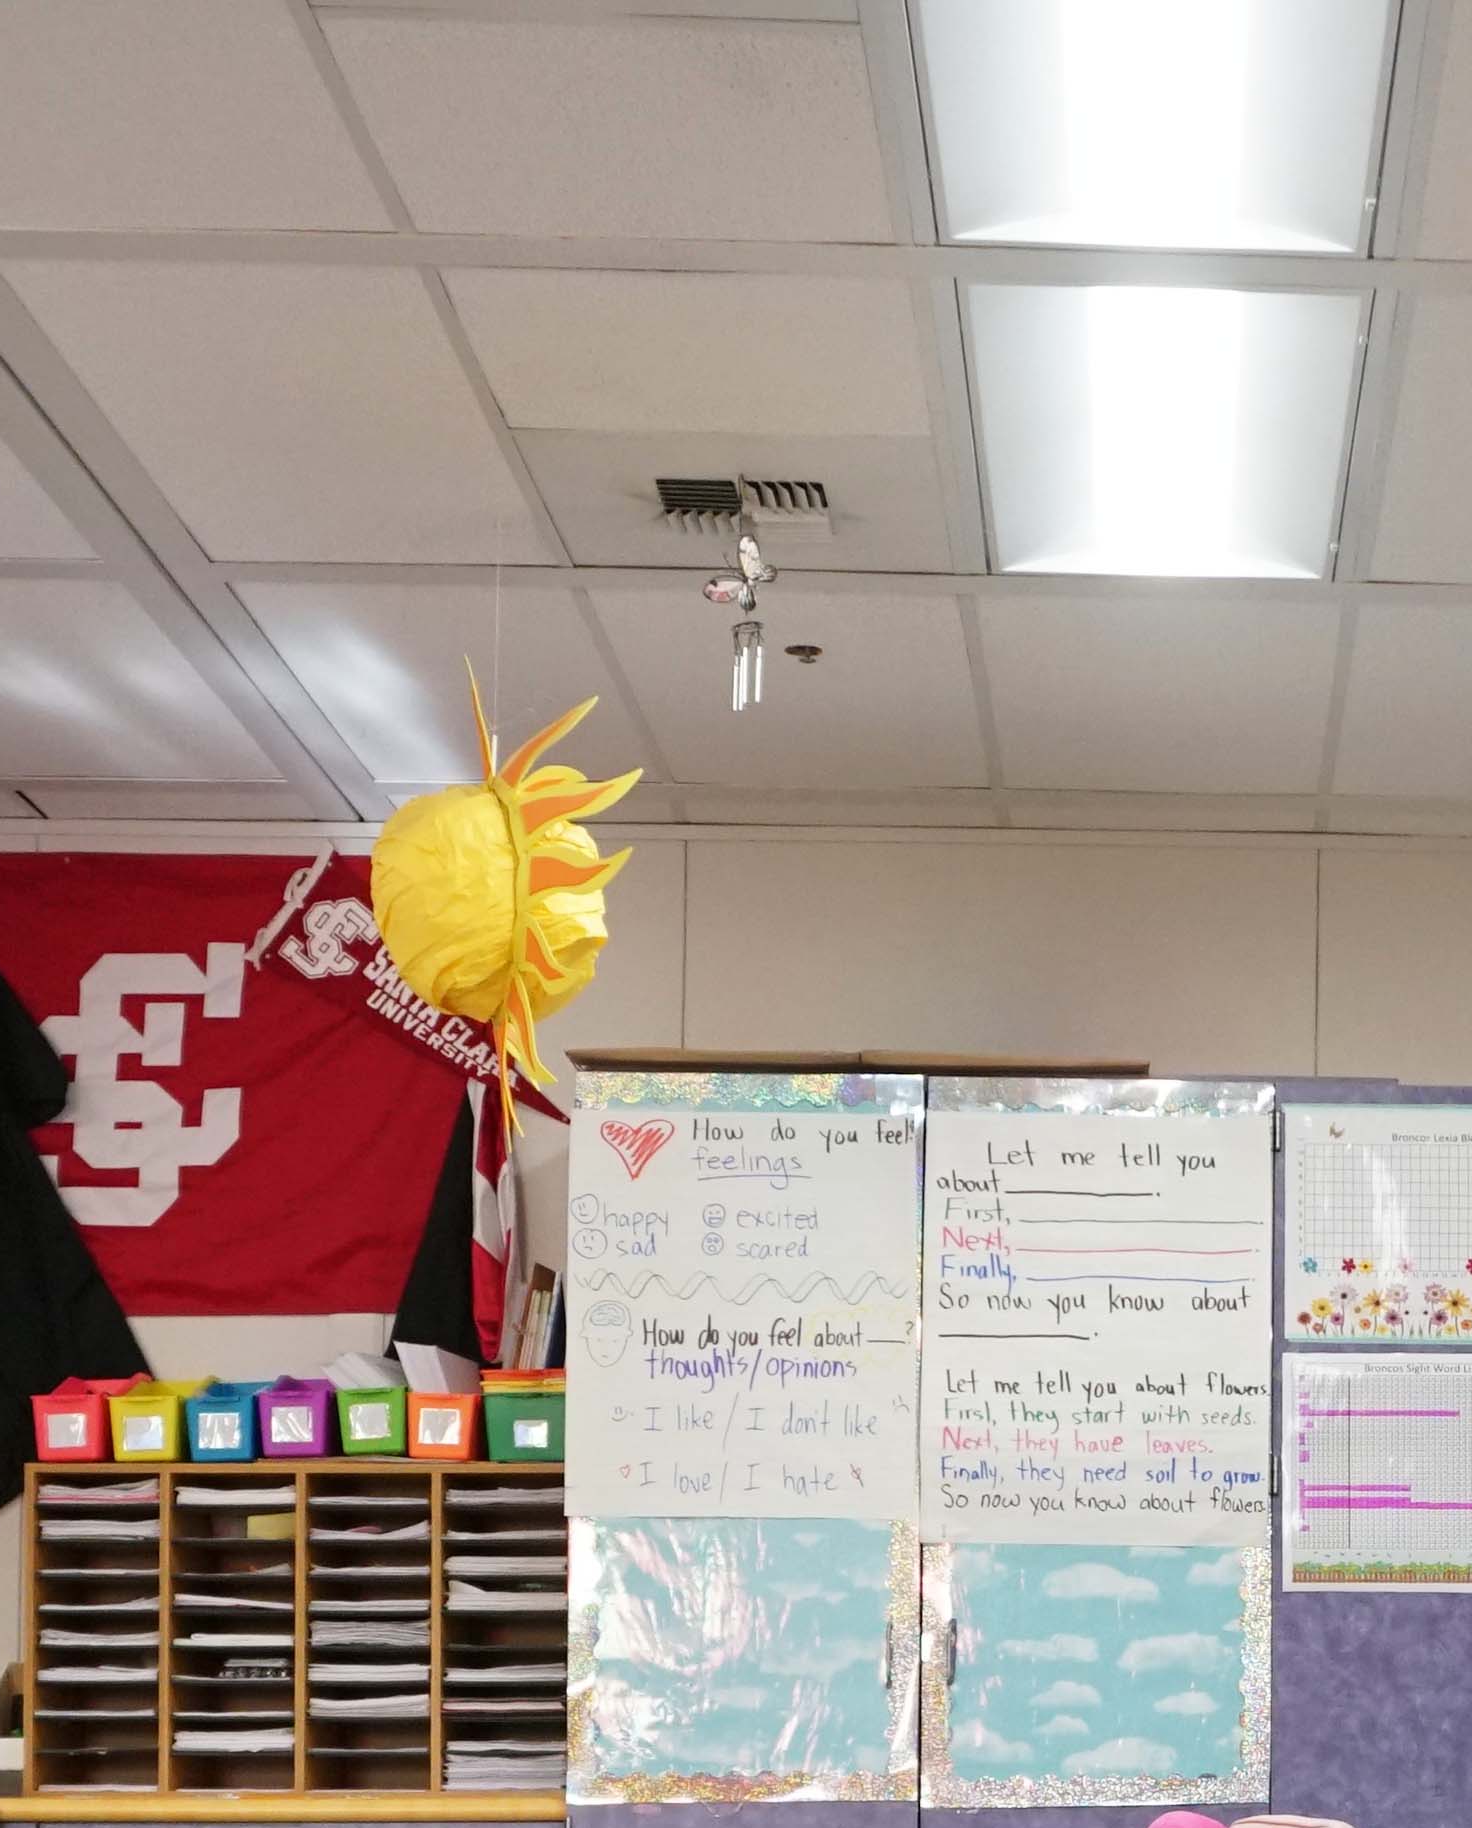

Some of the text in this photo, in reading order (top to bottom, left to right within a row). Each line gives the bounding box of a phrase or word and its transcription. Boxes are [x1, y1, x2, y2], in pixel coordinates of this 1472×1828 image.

[365, 988, 487, 1078] UNIVERSITY
[693, 1117, 743, 1141] How
[771, 1118, 796, 1141] do
[819, 1129, 858, 1154] you
[1434, 1133, 1458, 1143] Lexia
[691, 1148, 802, 1190] feelings
[988, 1139, 1215, 1177] Let me tell you
[936, 1168, 1000, 1193] about
[603, 1202, 819, 1236] happy excited
[944, 1197, 1011, 1225] First,
[616, 1235, 809, 1257] sad scared
[941, 1223, 1011, 1259] Next,
[940, 1252, 1017, 1293] Finally,
[939, 1282, 1251, 1325] So now you know about
[642, 1315, 863, 1358] How do you feel about
[946, 1369, 978, 1394] Let
[994, 1380, 1021, 1395] me
[1035, 1369, 1071, 1395] tell
[1081, 1381, 1117, 1405] you
[1136, 1372, 1188, 1396] about
[1364, 1364, 1404, 1373] Broncos
[1406, 1364, 1430, 1374] Sight
[1434, 1364, 1460, 1373] Word
[644, 1406, 663, 1432] I
[676, 1403, 714, 1431] like
[745, 1407, 765, 1431] I
[781, 1399, 831, 1435] don't
[844, 1404, 880, 1436] like
[1010, 1400, 1060, 1434] they
[1072, 1400, 1126, 1424] start
[1142, 1405, 1191, 1424] with
[1201, 1405, 1257, 1425] seeds.
[1013, 1429, 1060, 1455] they
[1074, 1430, 1124, 1453] have
[1146, 1430, 1213, 1455] leaves.
[639, 1461, 656, 1486] I
[744, 1463, 761, 1491] I
[783, 1464, 838, 1492] hate
[941, 1455, 1265, 1492] Finally, they need soil to grow.
[940, 1484, 969, 1509] So
[980, 1493, 1021, 1508] now
[1030, 1492, 1065, 1516] you
[1074, 1488, 1127, 1512] know
[1139, 1489, 1197, 1512] about
